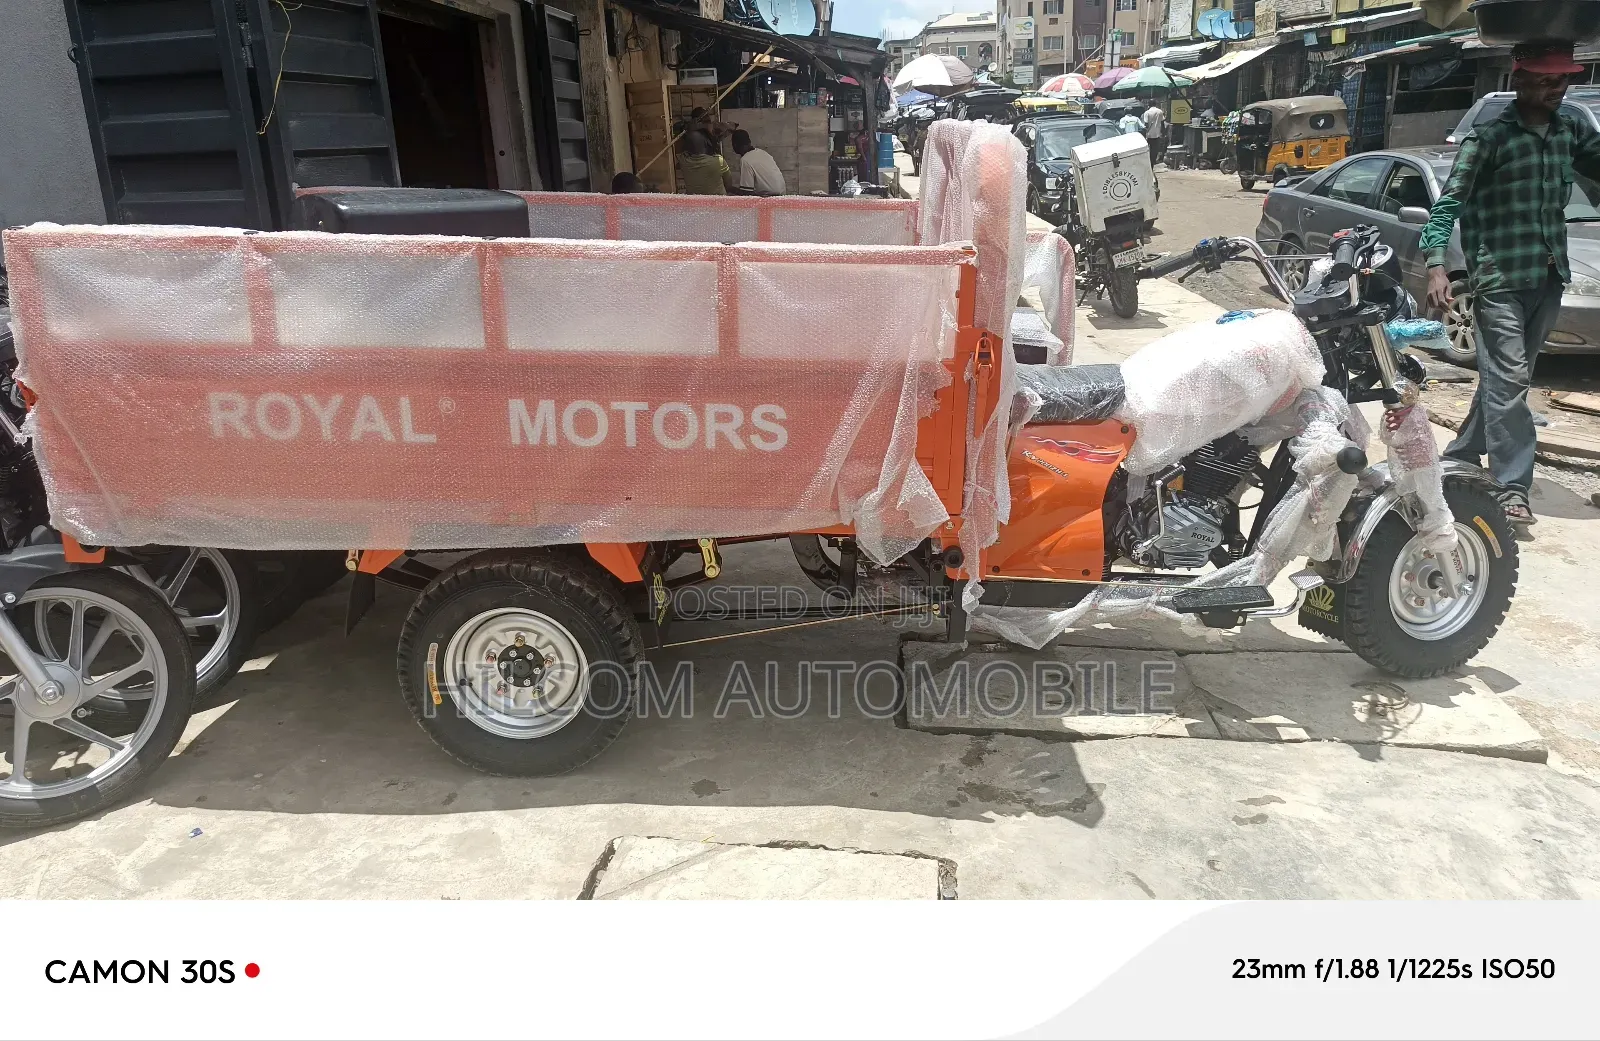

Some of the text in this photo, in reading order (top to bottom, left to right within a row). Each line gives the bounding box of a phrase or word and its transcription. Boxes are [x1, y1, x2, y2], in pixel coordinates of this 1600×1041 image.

[207, 391, 437, 444] ROYAL
[508, 399, 789, 451] MOTORS
[1191, 532, 1215, 543] ROYAL
[1302, 604, 1339, 624] MOTORCYCLE
